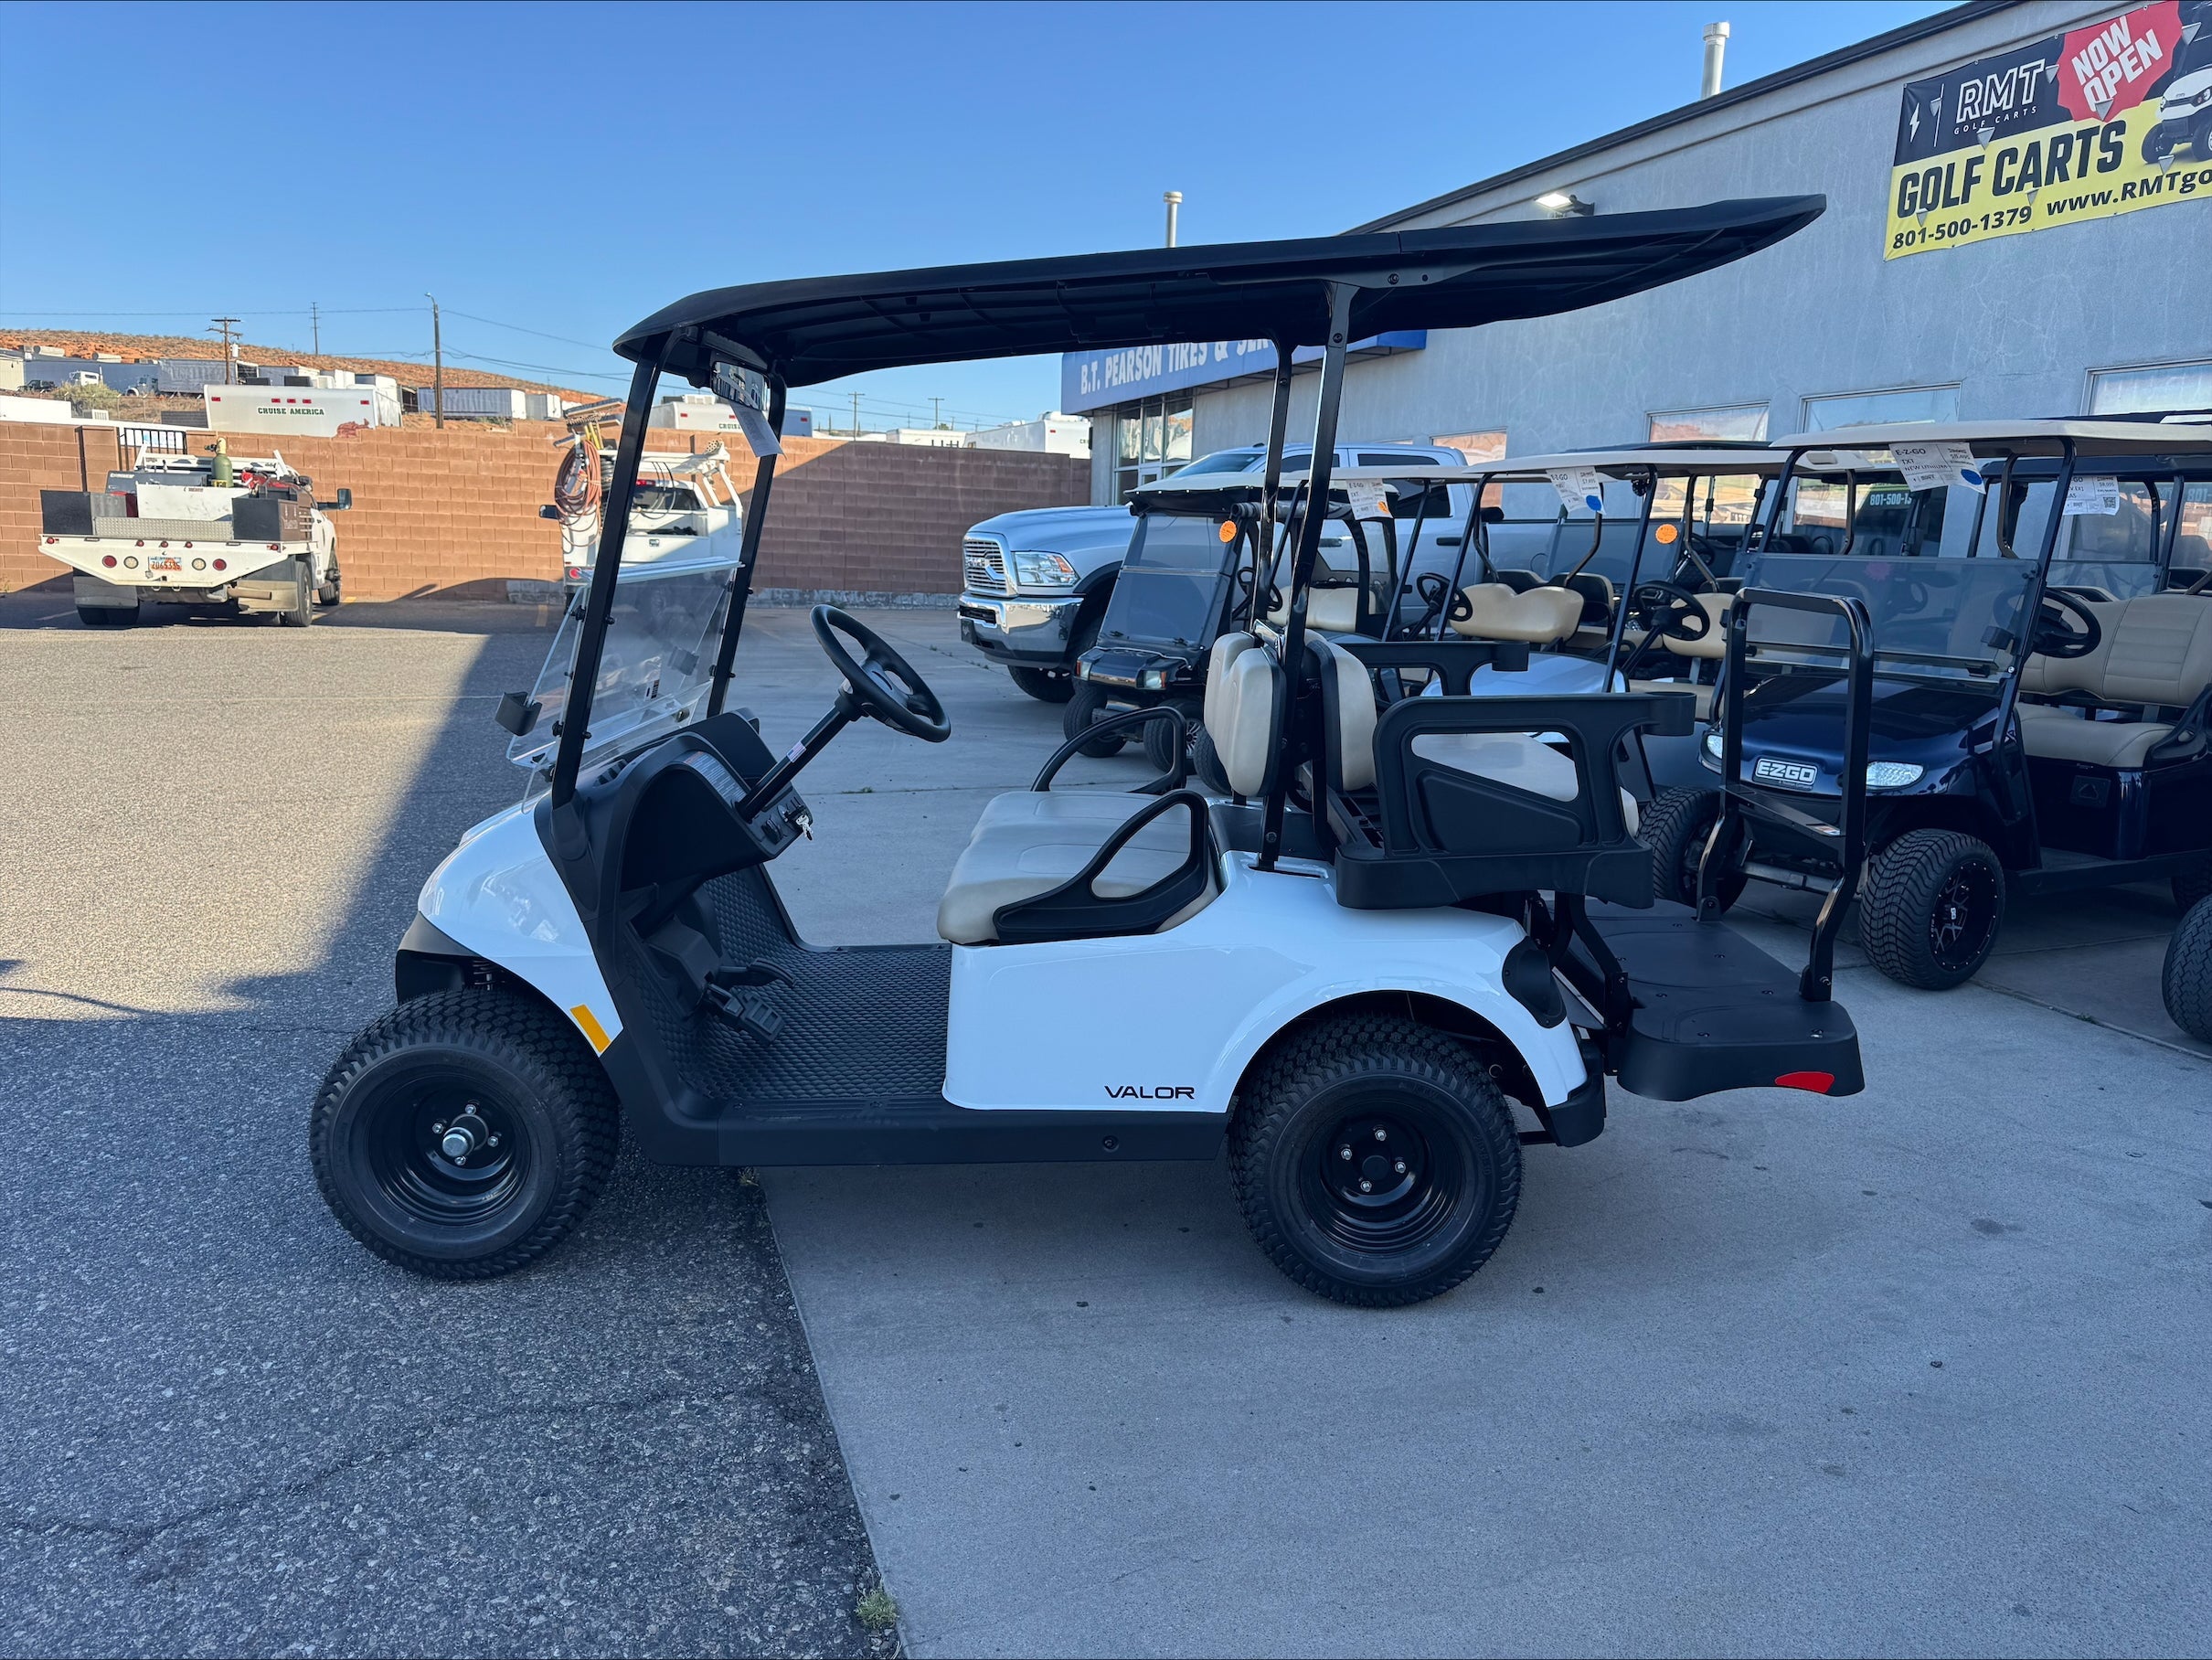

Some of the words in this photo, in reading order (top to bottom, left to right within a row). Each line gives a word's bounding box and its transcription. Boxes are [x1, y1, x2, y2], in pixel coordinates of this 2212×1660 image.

[2071, 16, 2131, 86] NOW
[2084, 28, 2163, 112] OPEN
[1956, 59, 2046, 123] RMT
[1954, 121, 1985, 134] GOLF
[1995, 106, 2037, 123] CARTS
[1897, 154, 1985, 218] GOLF
[1992, 120, 2127, 197] CARTS
[1893, 207, 2032, 249] 801-500-1379
[1081, 360, 1101, 395] B.T.
[1105, 345, 1163, 388] PEARSON
[1168, 343, 1207, 373] TIRES
[1214, 341, 1228, 362] &
[1758, 761, 1815, 782] EZGO
[1104, 1085, 1195, 1100] VALOR
